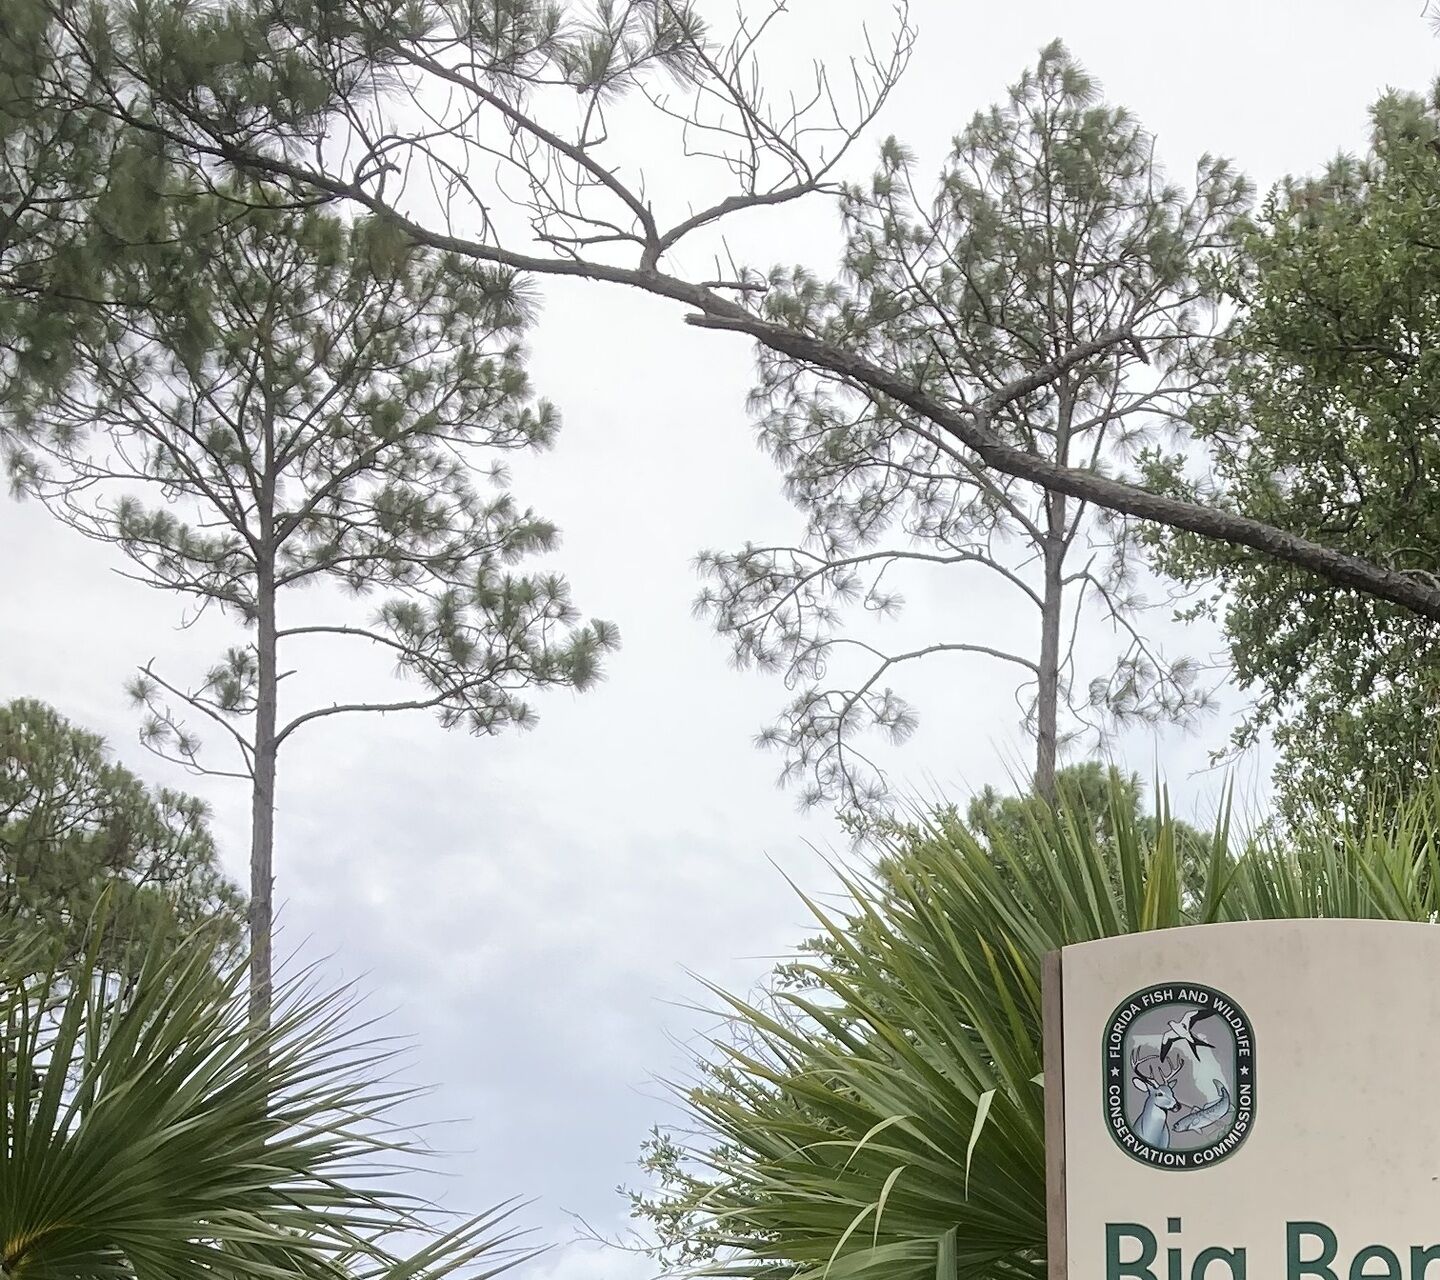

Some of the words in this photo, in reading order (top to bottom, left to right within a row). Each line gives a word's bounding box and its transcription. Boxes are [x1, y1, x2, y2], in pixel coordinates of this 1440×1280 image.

[1110, 1003, 1141, 1058] FLORIDA
[1142, 989, 1173, 1007] FISH
[1178, 989, 1209, 1004] AND
[1213, 997, 1250, 1057] WILDLIFE
[1110, 1085, 1186, 1166] CONSERVATION
[1193, 1084, 1251, 1164] COMMISSION
